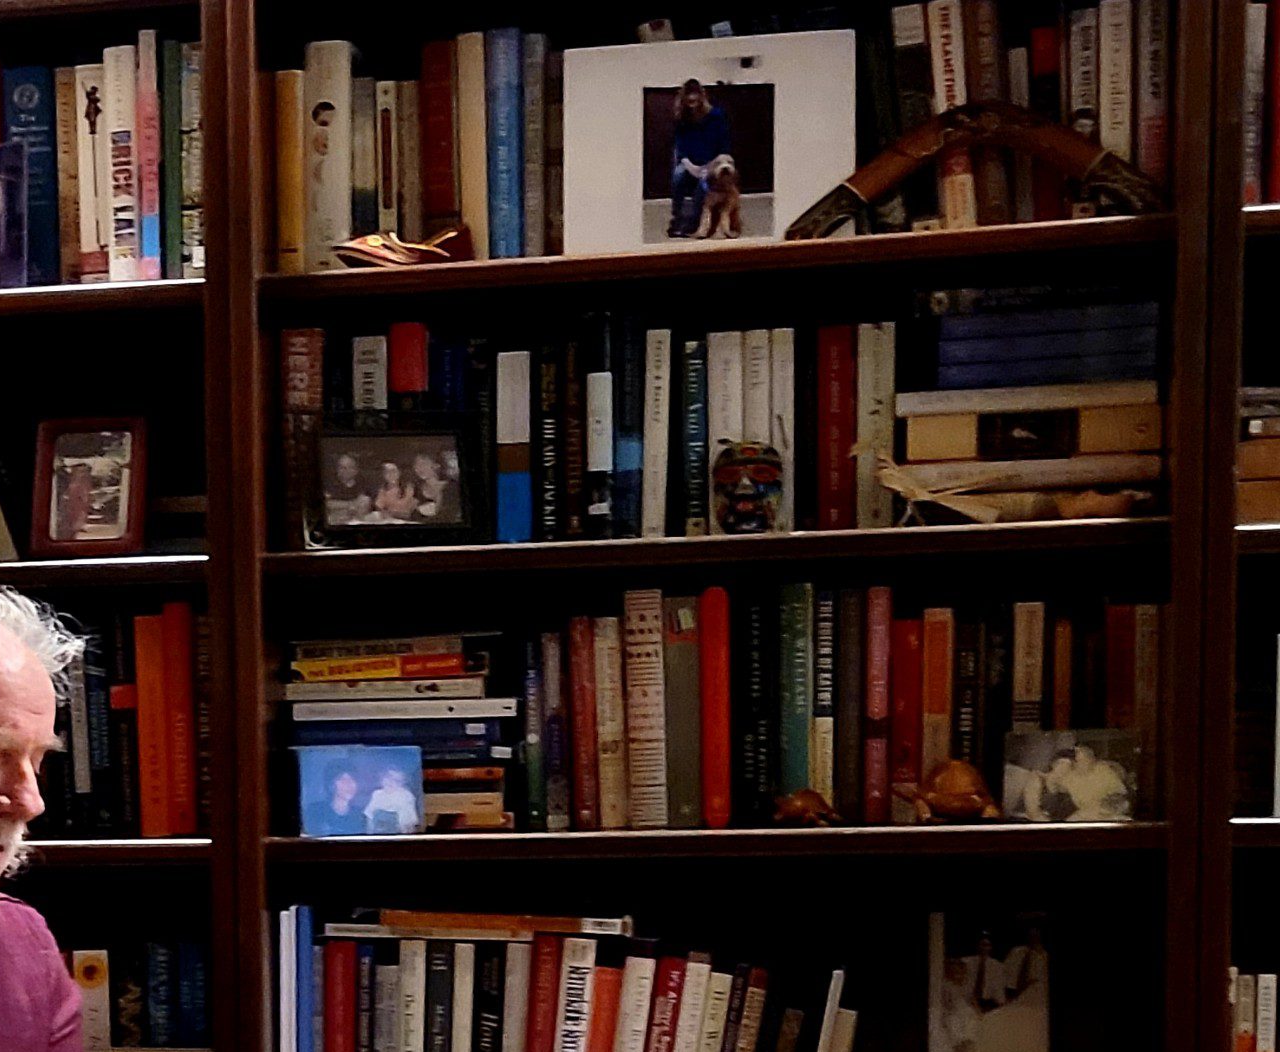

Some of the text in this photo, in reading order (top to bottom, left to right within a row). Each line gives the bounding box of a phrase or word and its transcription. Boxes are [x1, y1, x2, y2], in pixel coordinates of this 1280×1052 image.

[111, 130, 135, 260] BRICK LANE
[817, 600, 832, 618] THE
[817, 622, 832, 655] QUEEN
[794, 637, 806, 715] WILLIAMS
[817, 658, 832, 669] OF
[478, 1009, 499, 1052] How
